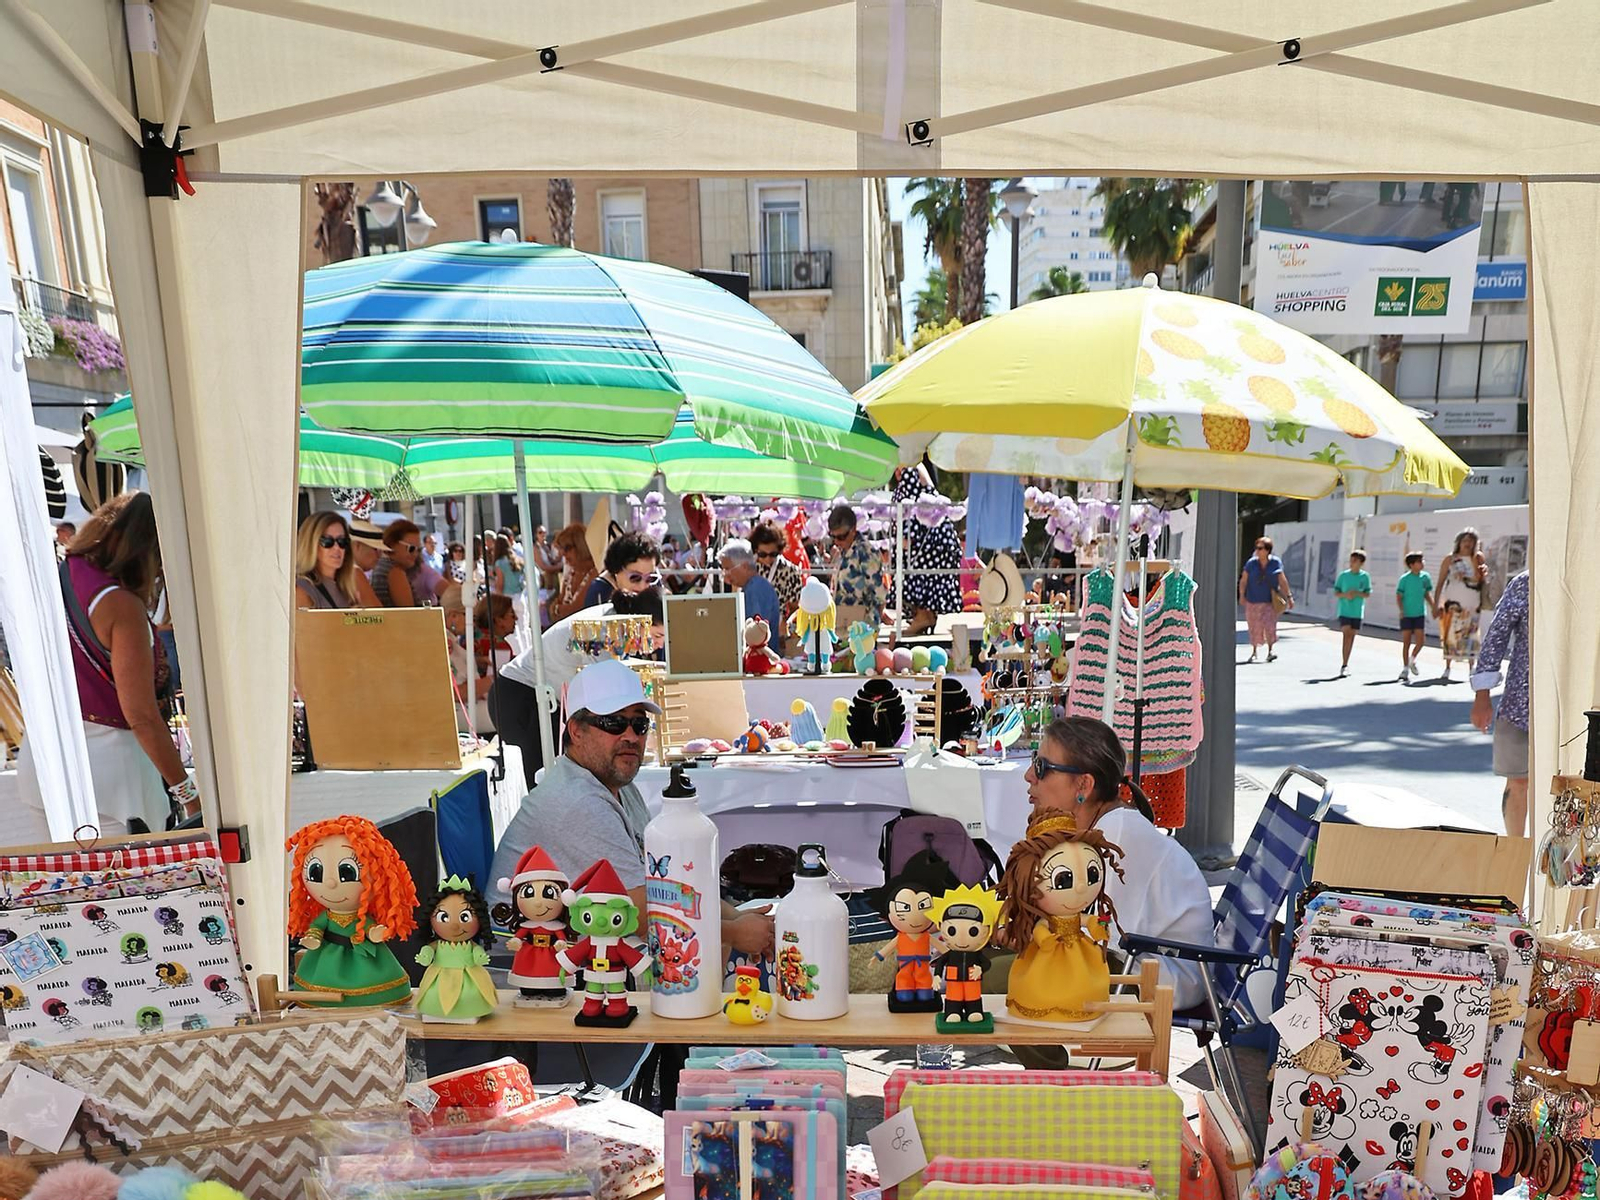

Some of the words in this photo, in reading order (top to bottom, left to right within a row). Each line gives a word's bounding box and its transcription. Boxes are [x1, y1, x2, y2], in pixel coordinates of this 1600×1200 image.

[1269, 243, 1310, 251] HUELVA
[1273, 299, 1347, 313] SHOPPING
[1288, 1013, 1312, 1030] 12€
[891, 1126, 913, 1152] 8€
